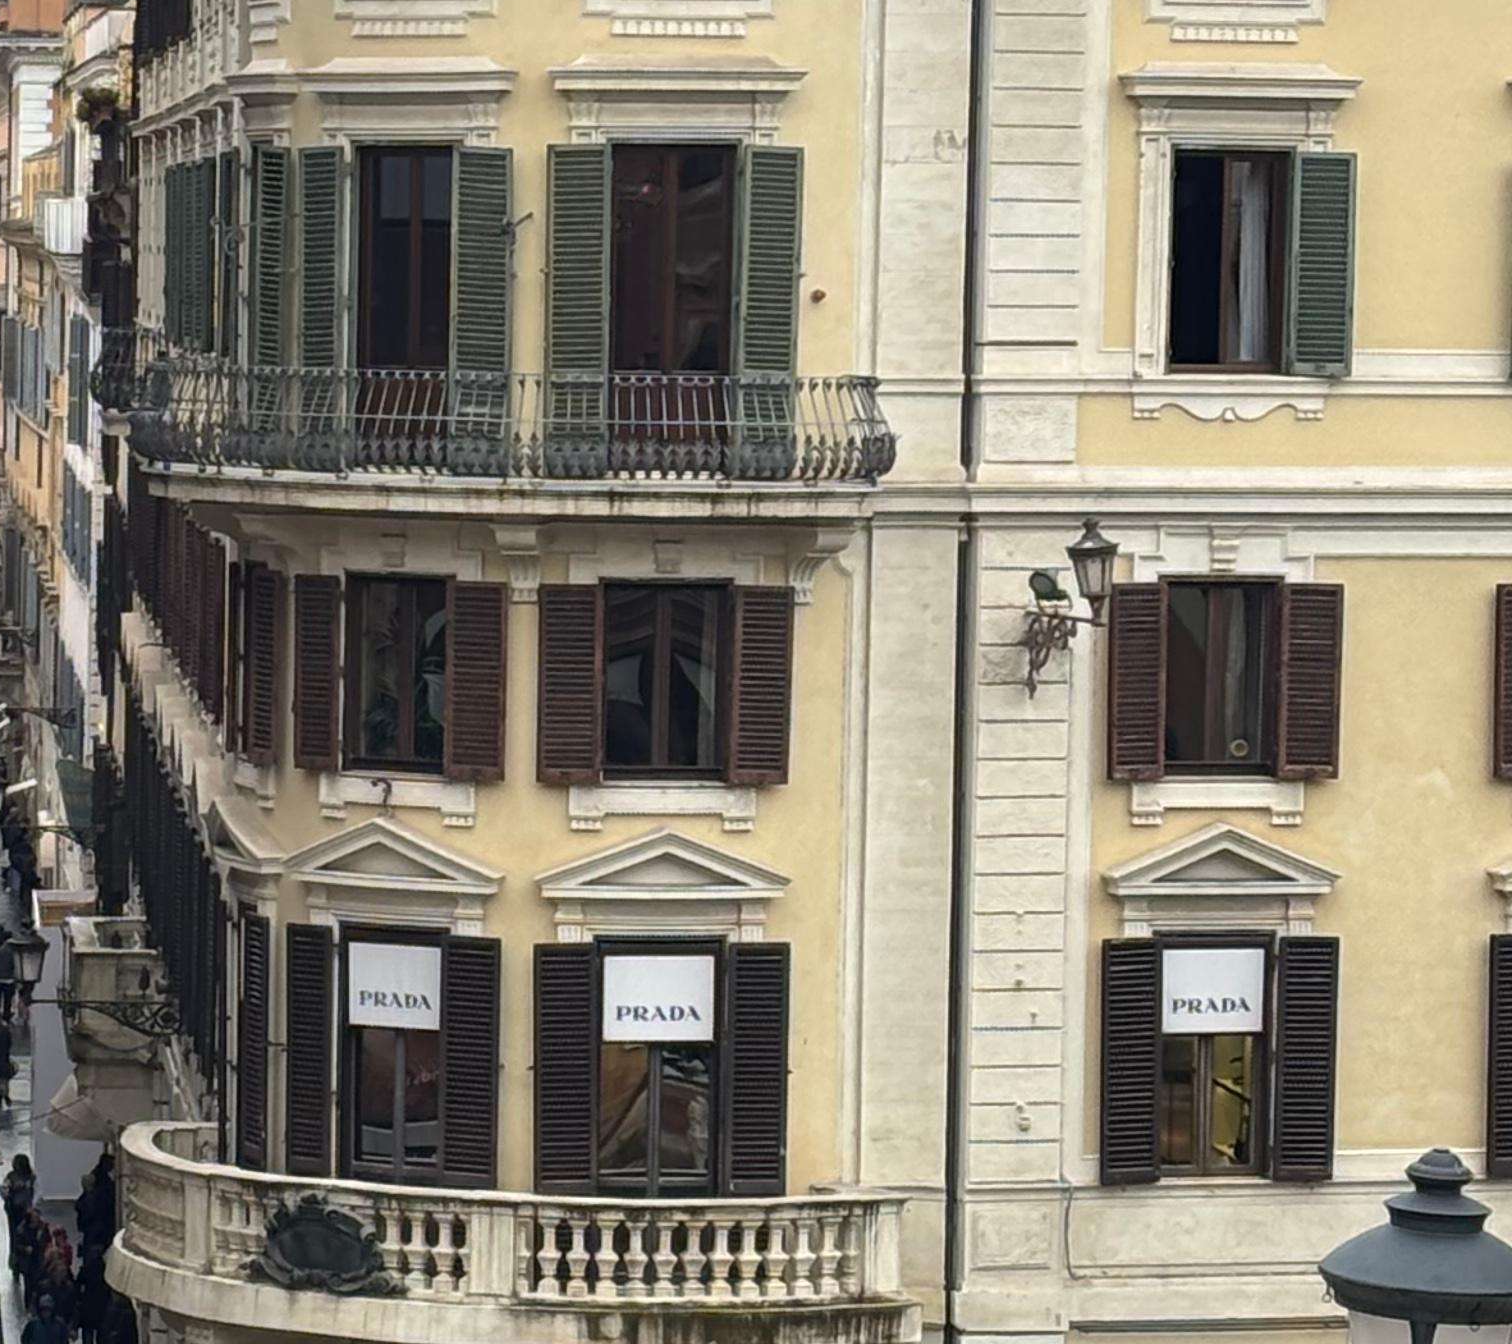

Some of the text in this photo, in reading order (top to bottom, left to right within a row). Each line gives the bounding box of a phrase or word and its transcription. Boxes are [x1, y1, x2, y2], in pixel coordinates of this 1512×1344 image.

[359, 990, 433, 1011] PRADA
[1172, 997, 1251, 1015] PRADA
[615, 1005, 702, 1022] PRADA
